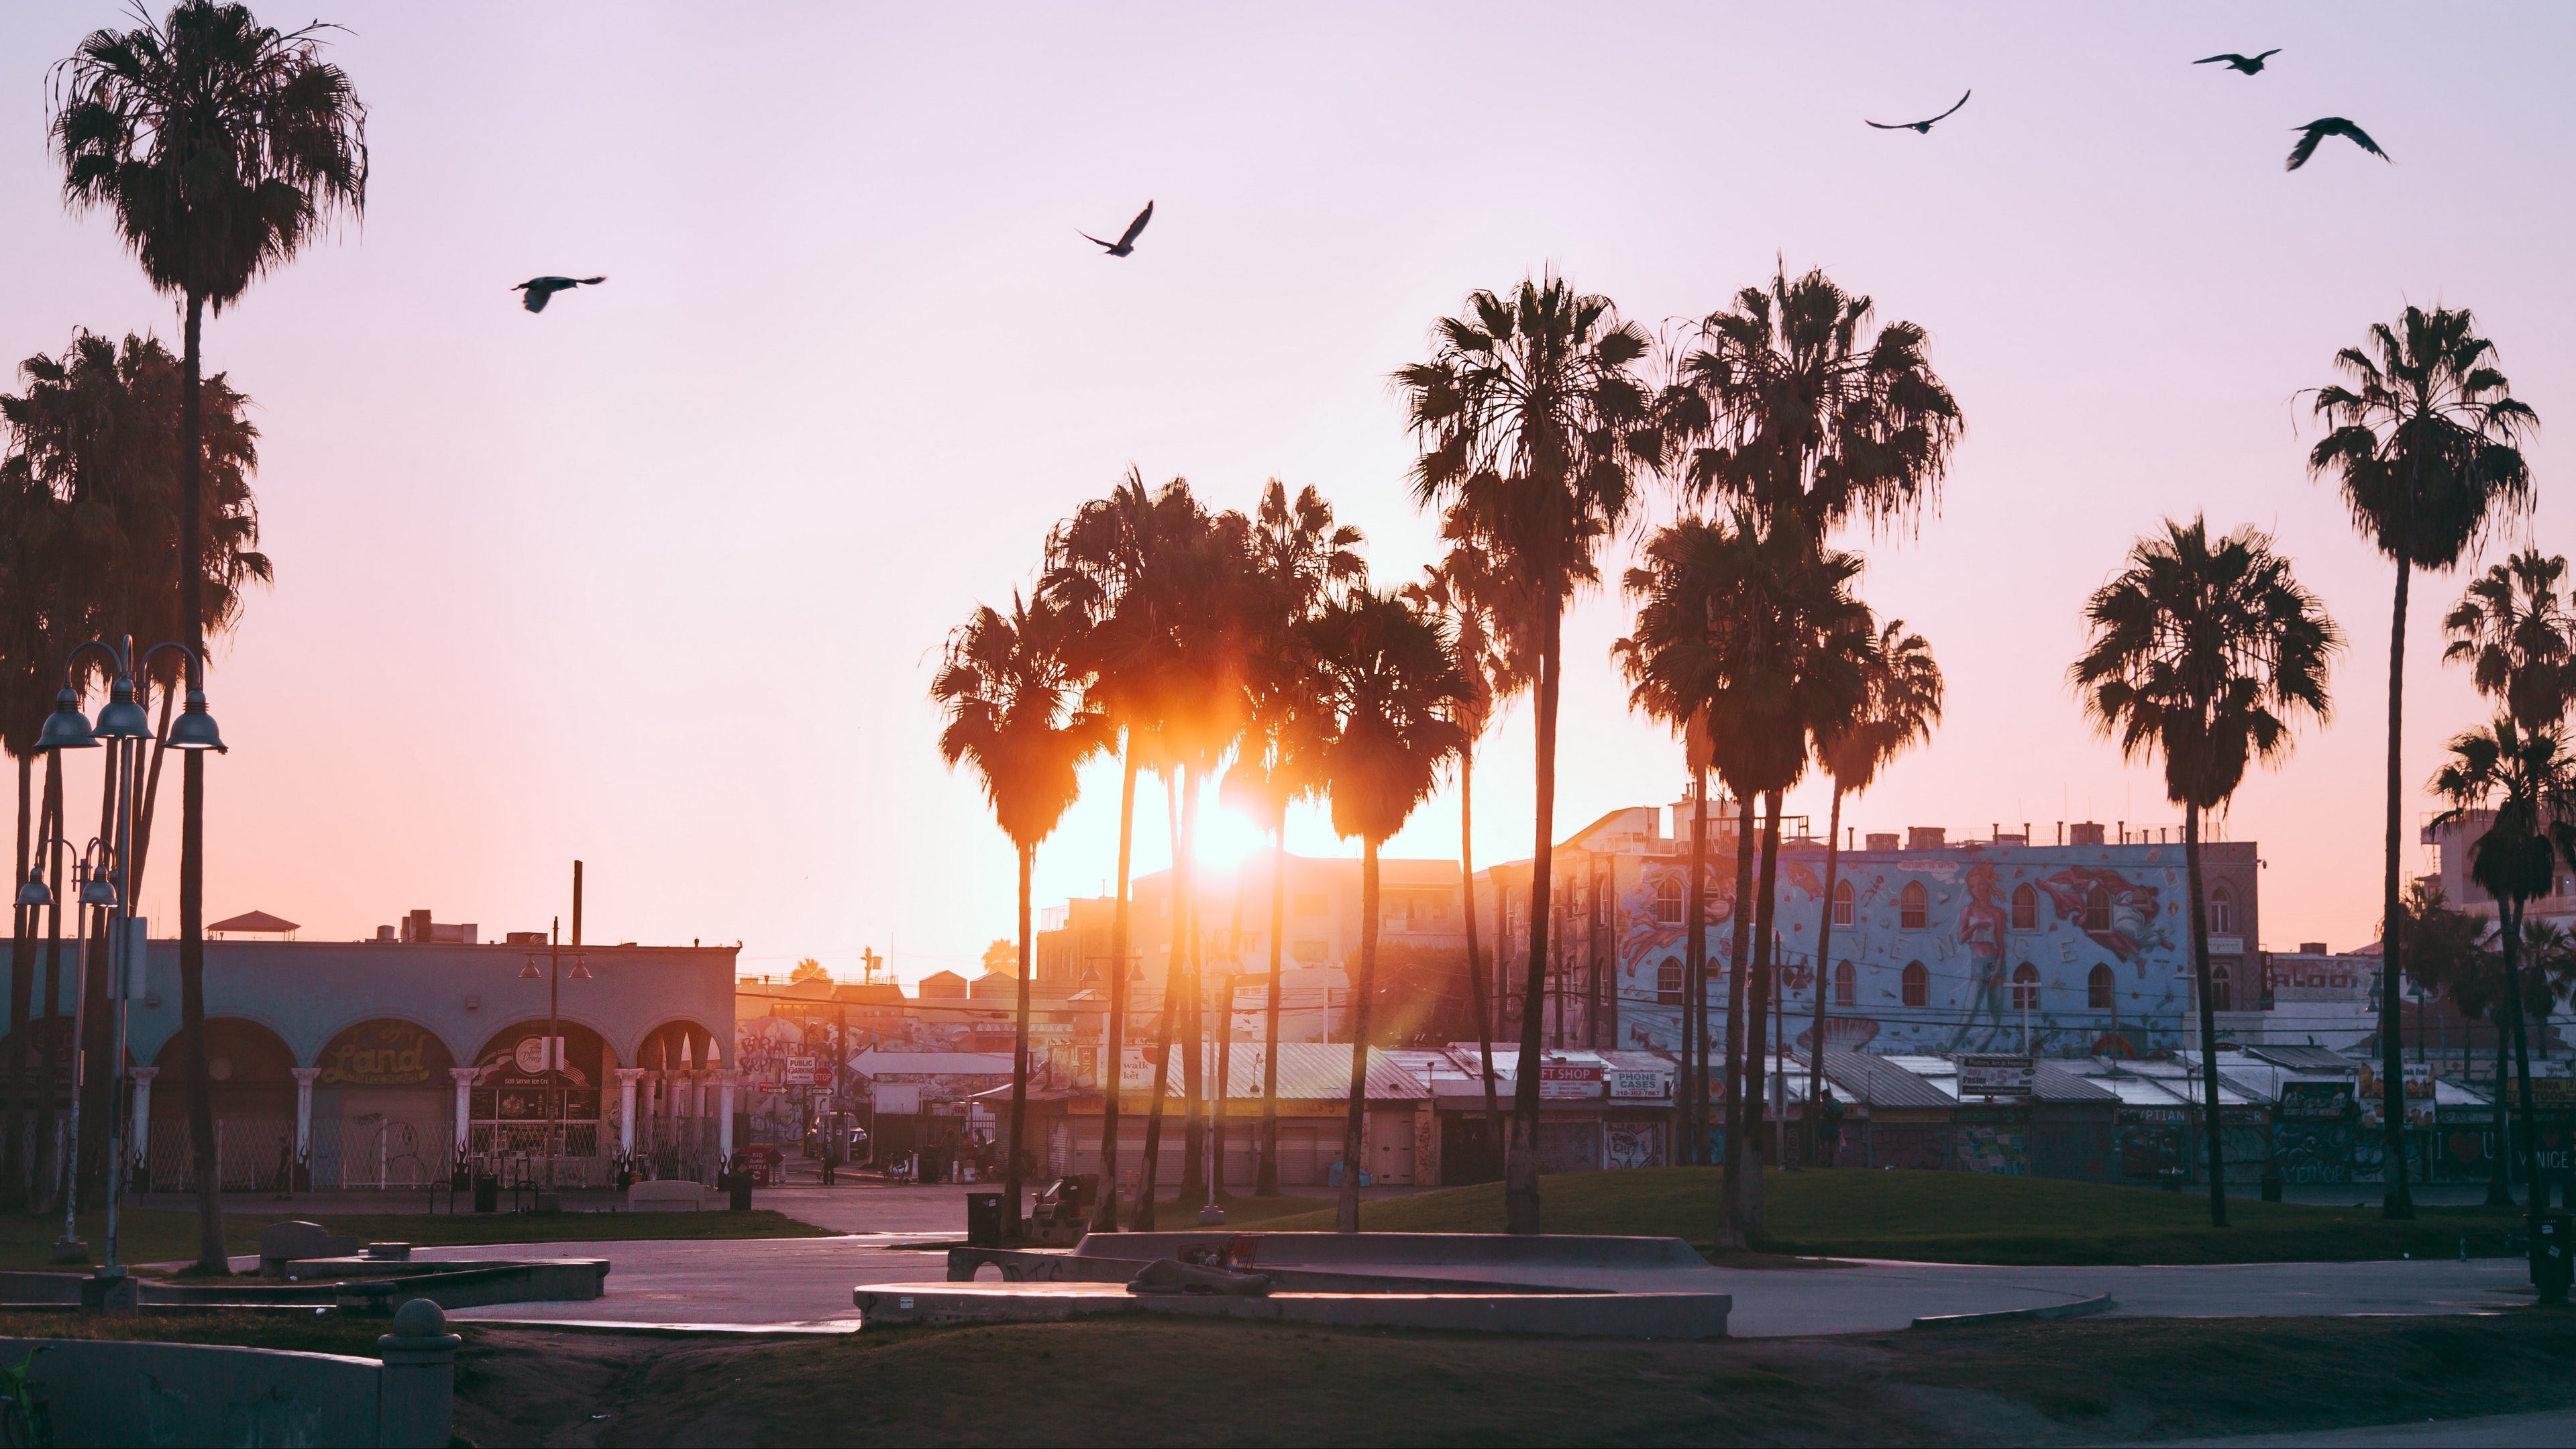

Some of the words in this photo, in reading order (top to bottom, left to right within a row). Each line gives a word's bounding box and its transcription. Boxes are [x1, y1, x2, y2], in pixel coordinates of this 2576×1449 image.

[2273, 967, 2358, 987] ALOO
[321, 1037, 431, 1084] Land
[1083, 1049, 1091, 1073] NICE
[1541, 1069, 1555, 1079] FT
[1558, 1069, 1591, 1079] SHOP
[1963, 1076, 1986, 1085] Poster
[2436, 1132, 2442, 1159] I
[2518, 1150, 2569, 1169] VNICE
